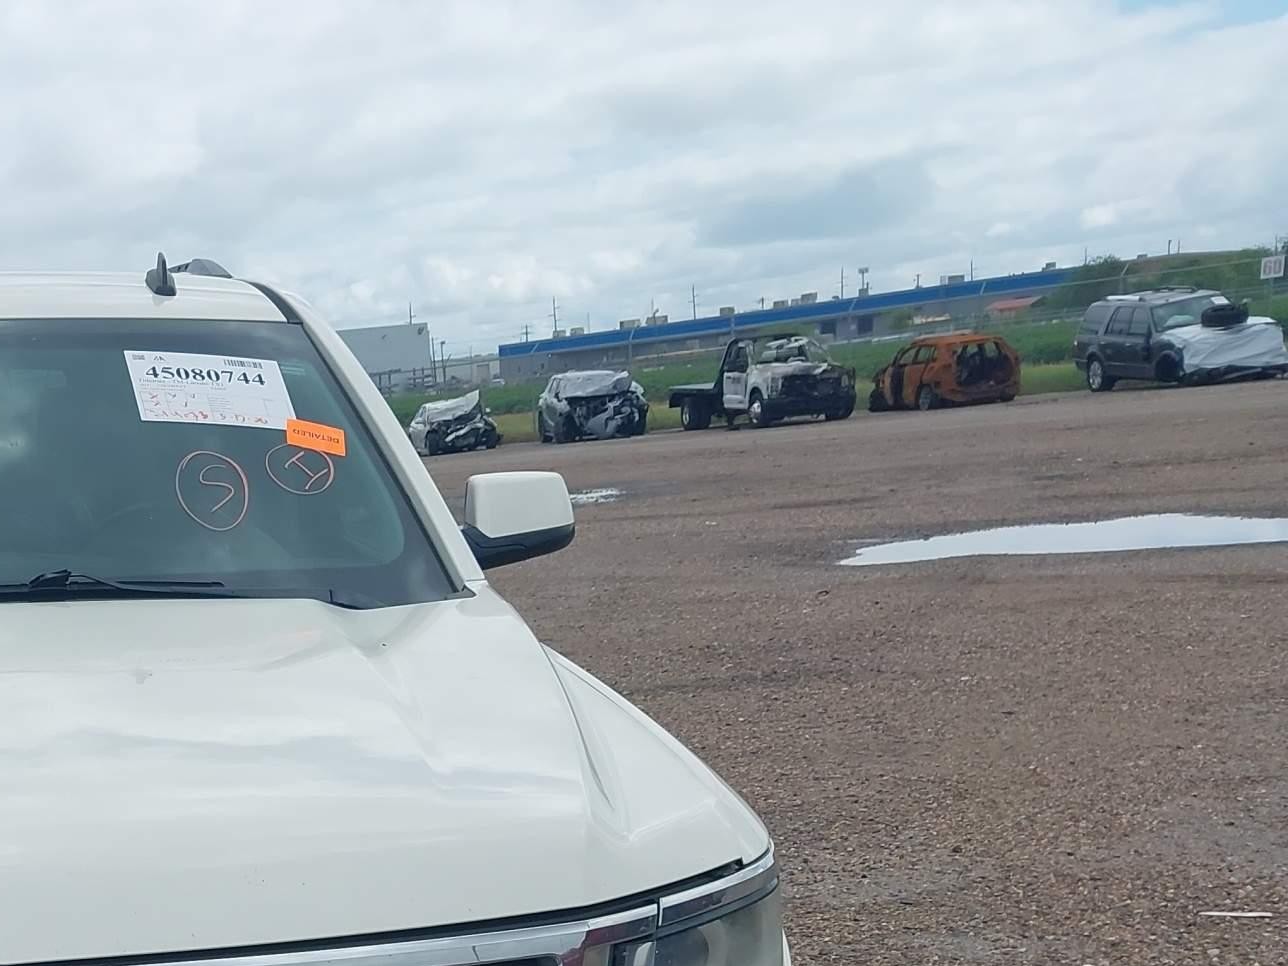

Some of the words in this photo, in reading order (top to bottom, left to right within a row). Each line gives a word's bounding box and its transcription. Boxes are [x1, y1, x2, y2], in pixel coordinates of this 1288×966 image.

[1263, 258, 1282, 276] 60
[145, 365, 266, 386] 45080744
[292, 427, 340, 444] DETAILED
